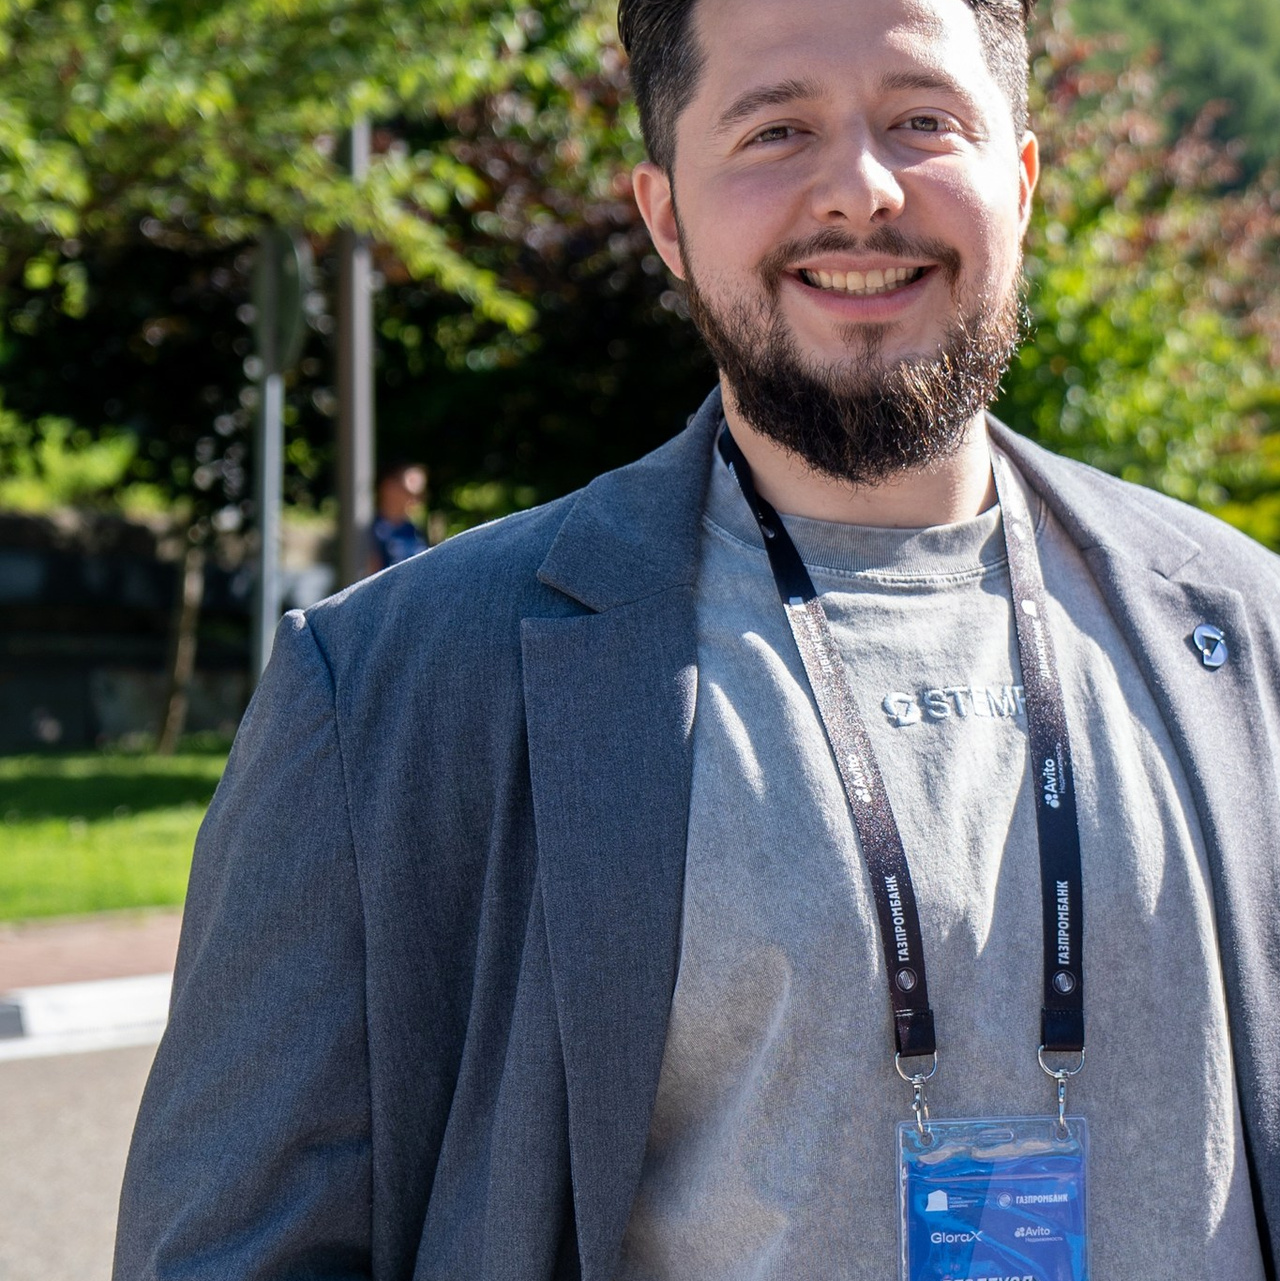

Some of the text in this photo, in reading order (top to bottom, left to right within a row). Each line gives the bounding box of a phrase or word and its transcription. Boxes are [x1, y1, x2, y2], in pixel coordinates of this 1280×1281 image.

[848, 753, 867, 789] Avito
[1043, 757, 1058, 794] Avito
[884, 875, 909, 962] ГАЗПРОМБАНК
[1056, 880, 1069, 965] ГАЗПРОМБАНК
[1015, 1193, 1068, 1205] ГАЗПРОМБАНК
[930, 1230, 983, 1244] GloraX
[1025, 1226, 1051, 1237] Avito
